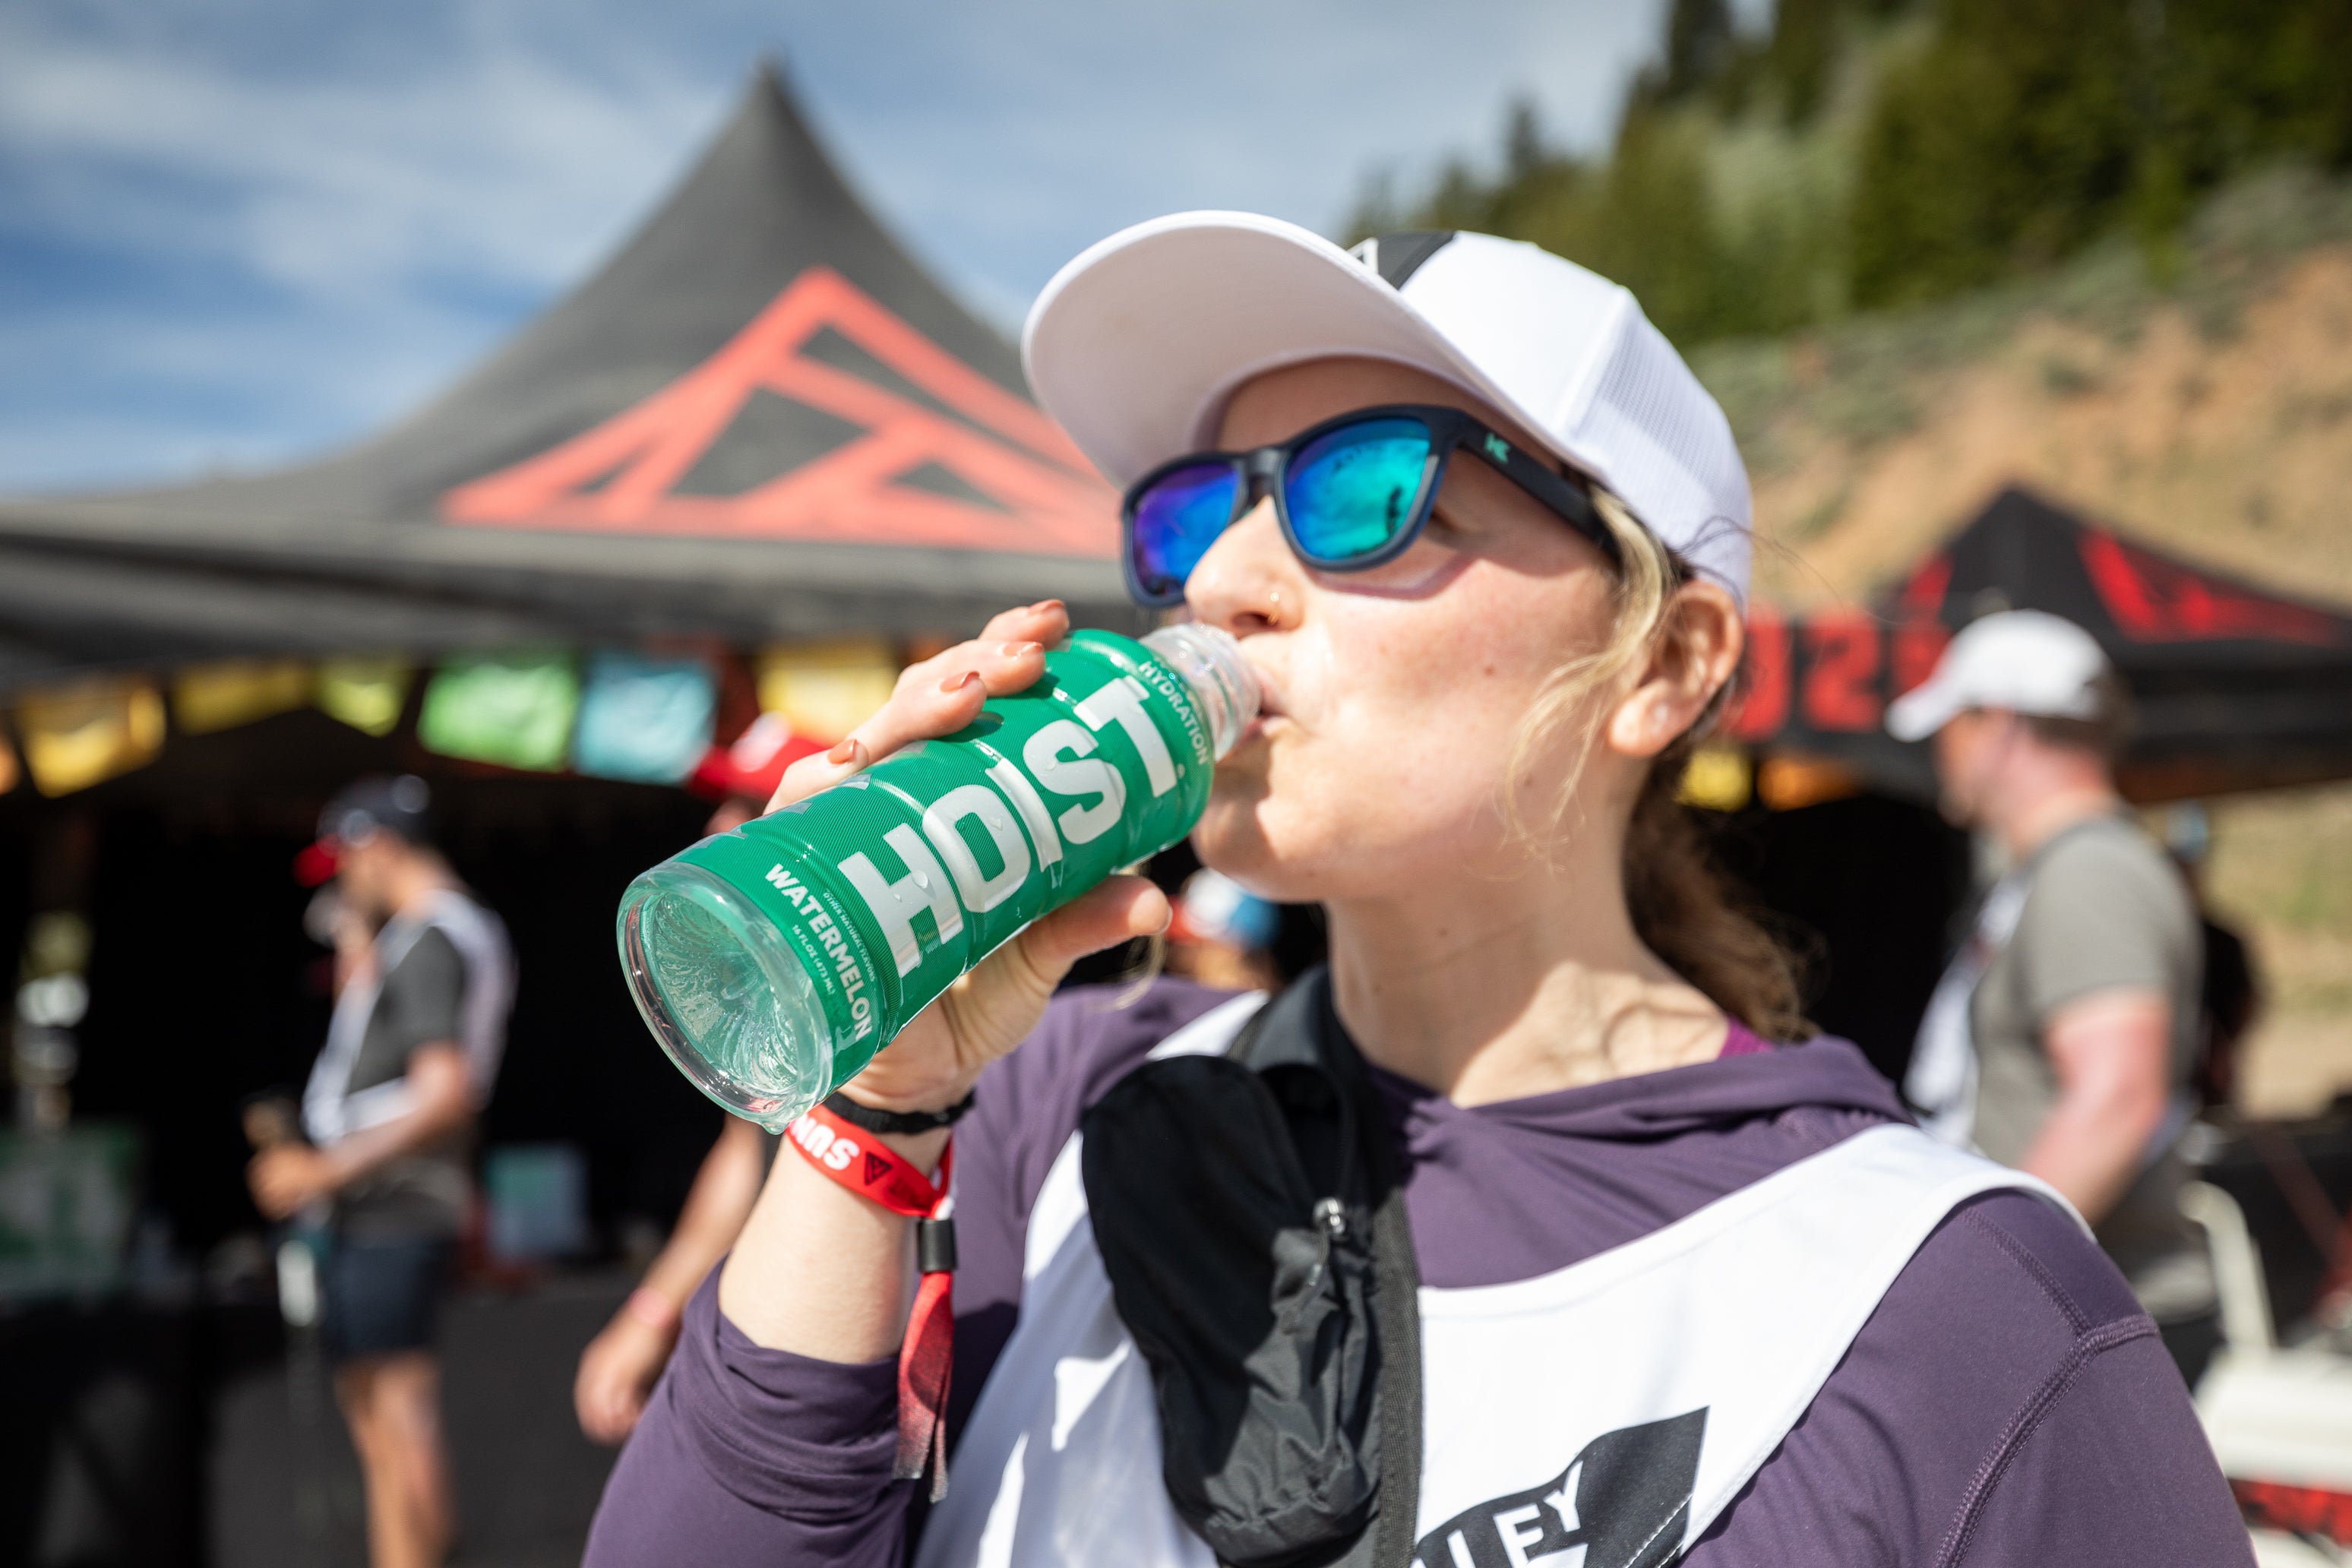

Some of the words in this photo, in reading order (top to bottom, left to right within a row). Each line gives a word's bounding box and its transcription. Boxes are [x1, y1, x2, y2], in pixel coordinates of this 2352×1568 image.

[1140, 661, 1209, 765] HYDRATION
[837, 675, 1178, 978] HOIST
[765, 863, 873, 1042] WATERMELON
[792, 925, 801, 935] 16
[814, 958, 828, 978] (473
[839, 914, 864, 949] NATURAL
[859, 947, 876, 982] FLAVORS
